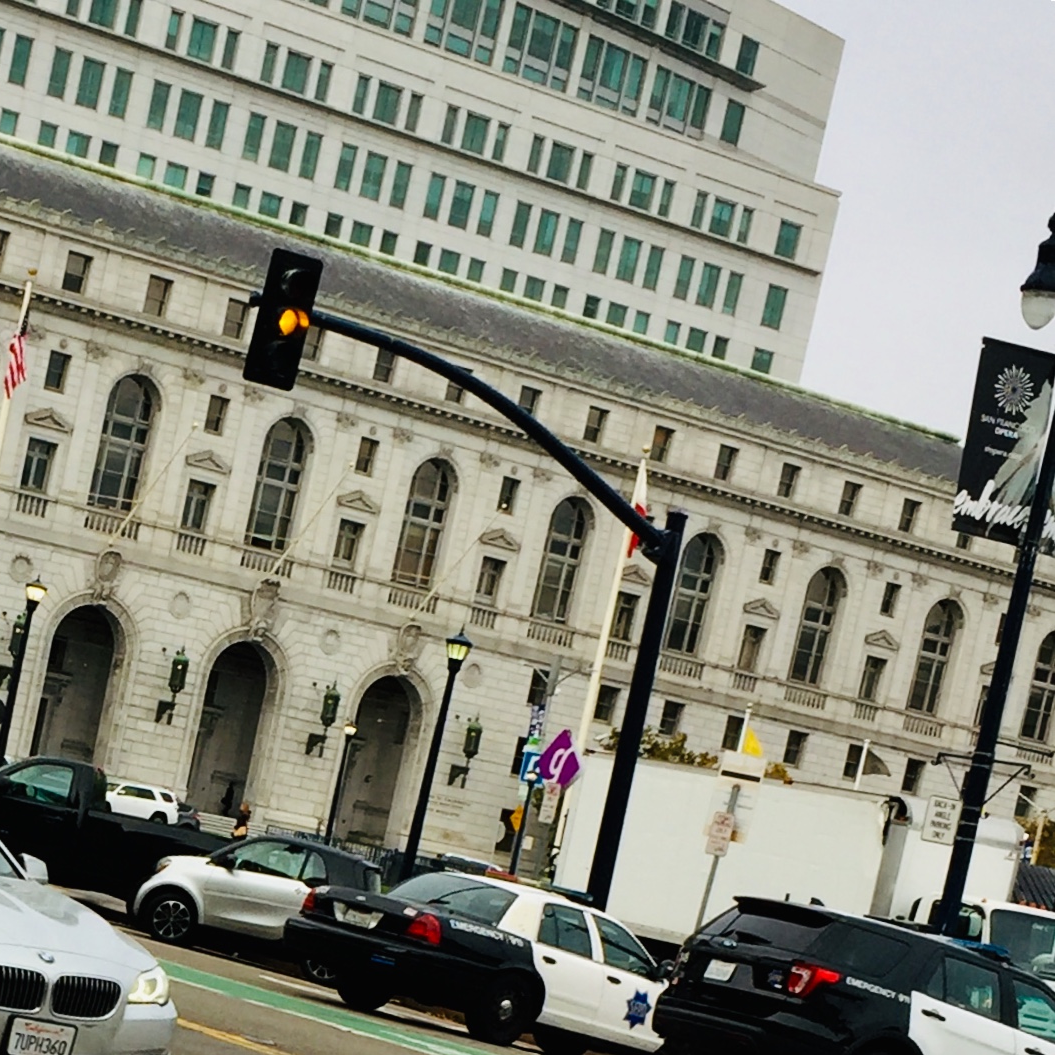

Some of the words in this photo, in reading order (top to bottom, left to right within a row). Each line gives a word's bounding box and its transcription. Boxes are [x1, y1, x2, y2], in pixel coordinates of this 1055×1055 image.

[980, 413, 995, 425] SAN
[994, 426, 1019, 439] OPERA
[846, 976, 896, 999] EMERGENCY
